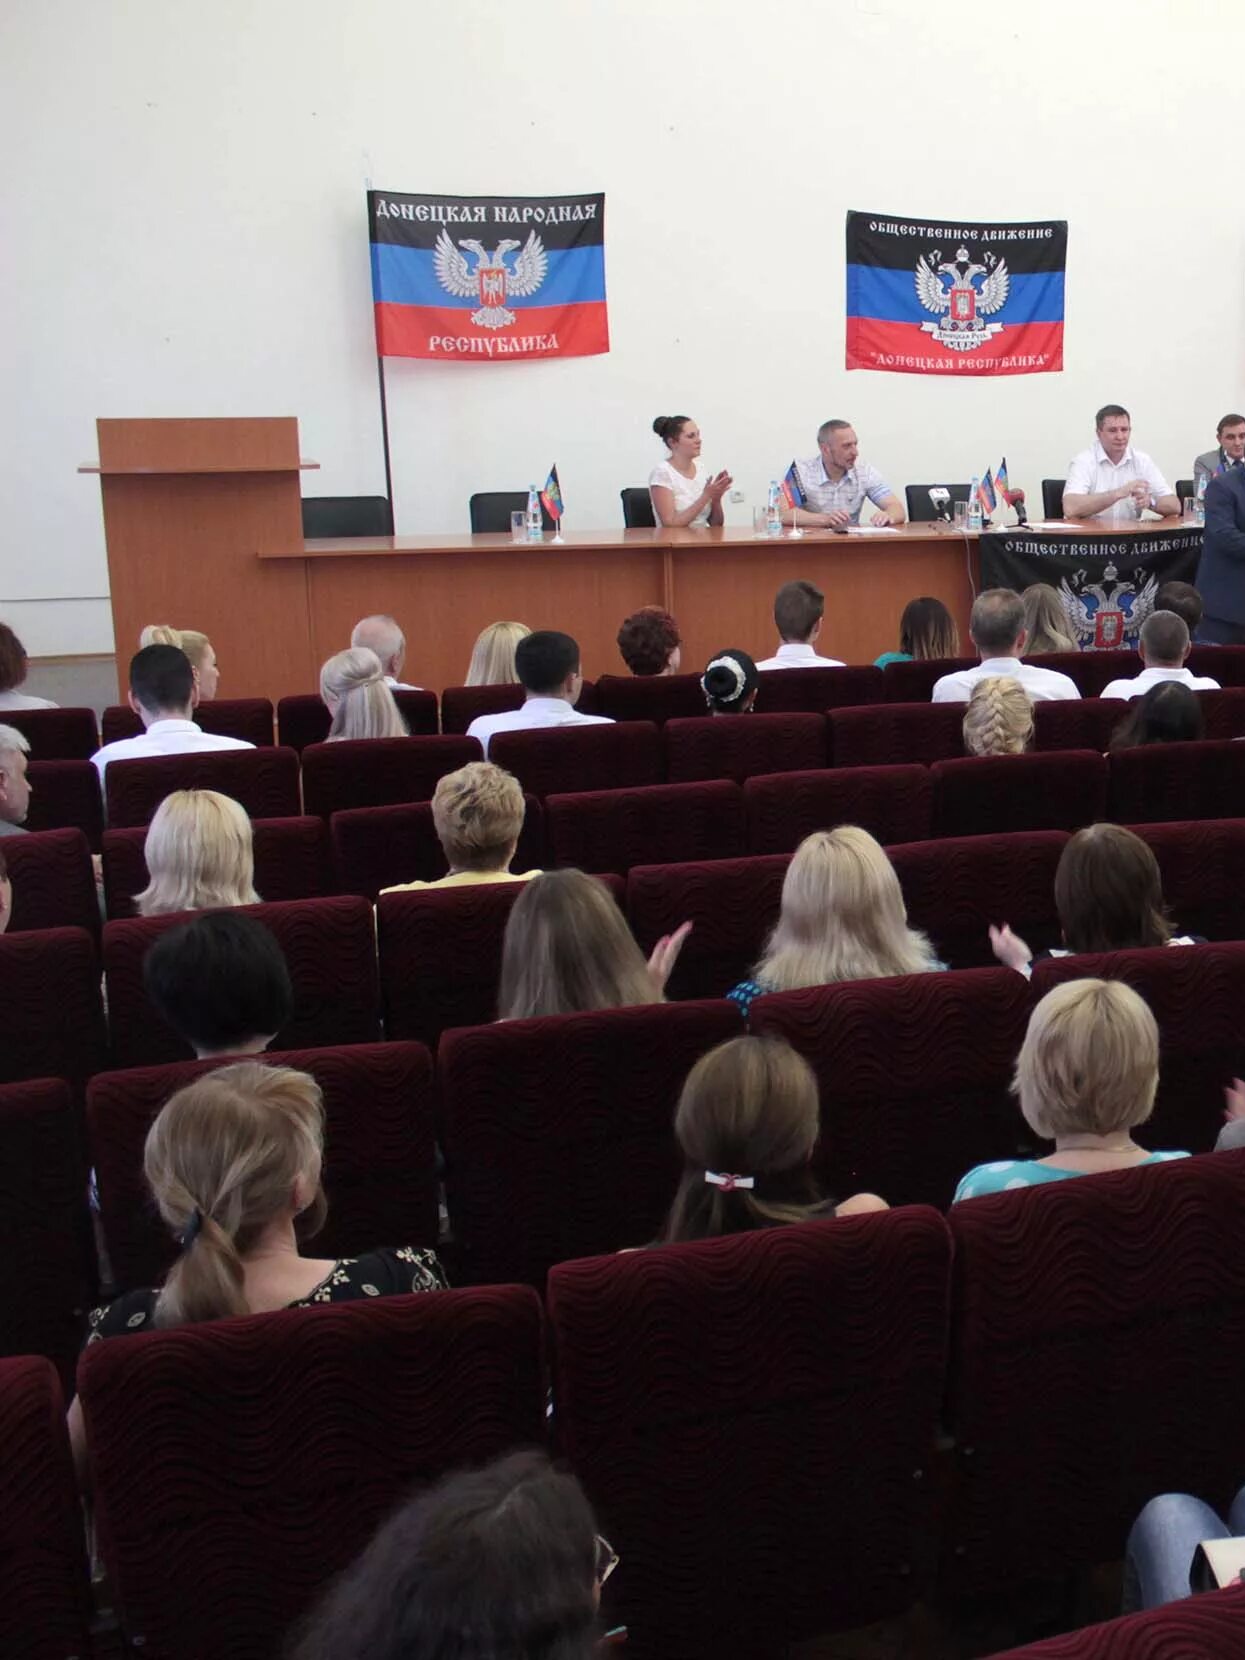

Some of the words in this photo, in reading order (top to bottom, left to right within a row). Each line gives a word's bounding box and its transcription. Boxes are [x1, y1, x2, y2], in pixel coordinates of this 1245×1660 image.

[376, 199, 487, 225] ДОНЕЦКАЯ
[494, 203, 598, 226] НАРОДНАЯ
[869, 220, 978, 240] ОБЩЕСТВЕННОЕ
[981, 227, 1054, 242] ДВИЖЕНИЕ
[428, 333, 559, 357] РЕСПУБЛИКА
[1004, 540, 1127, 557] ОБЩЕСТВЕННОЕ
